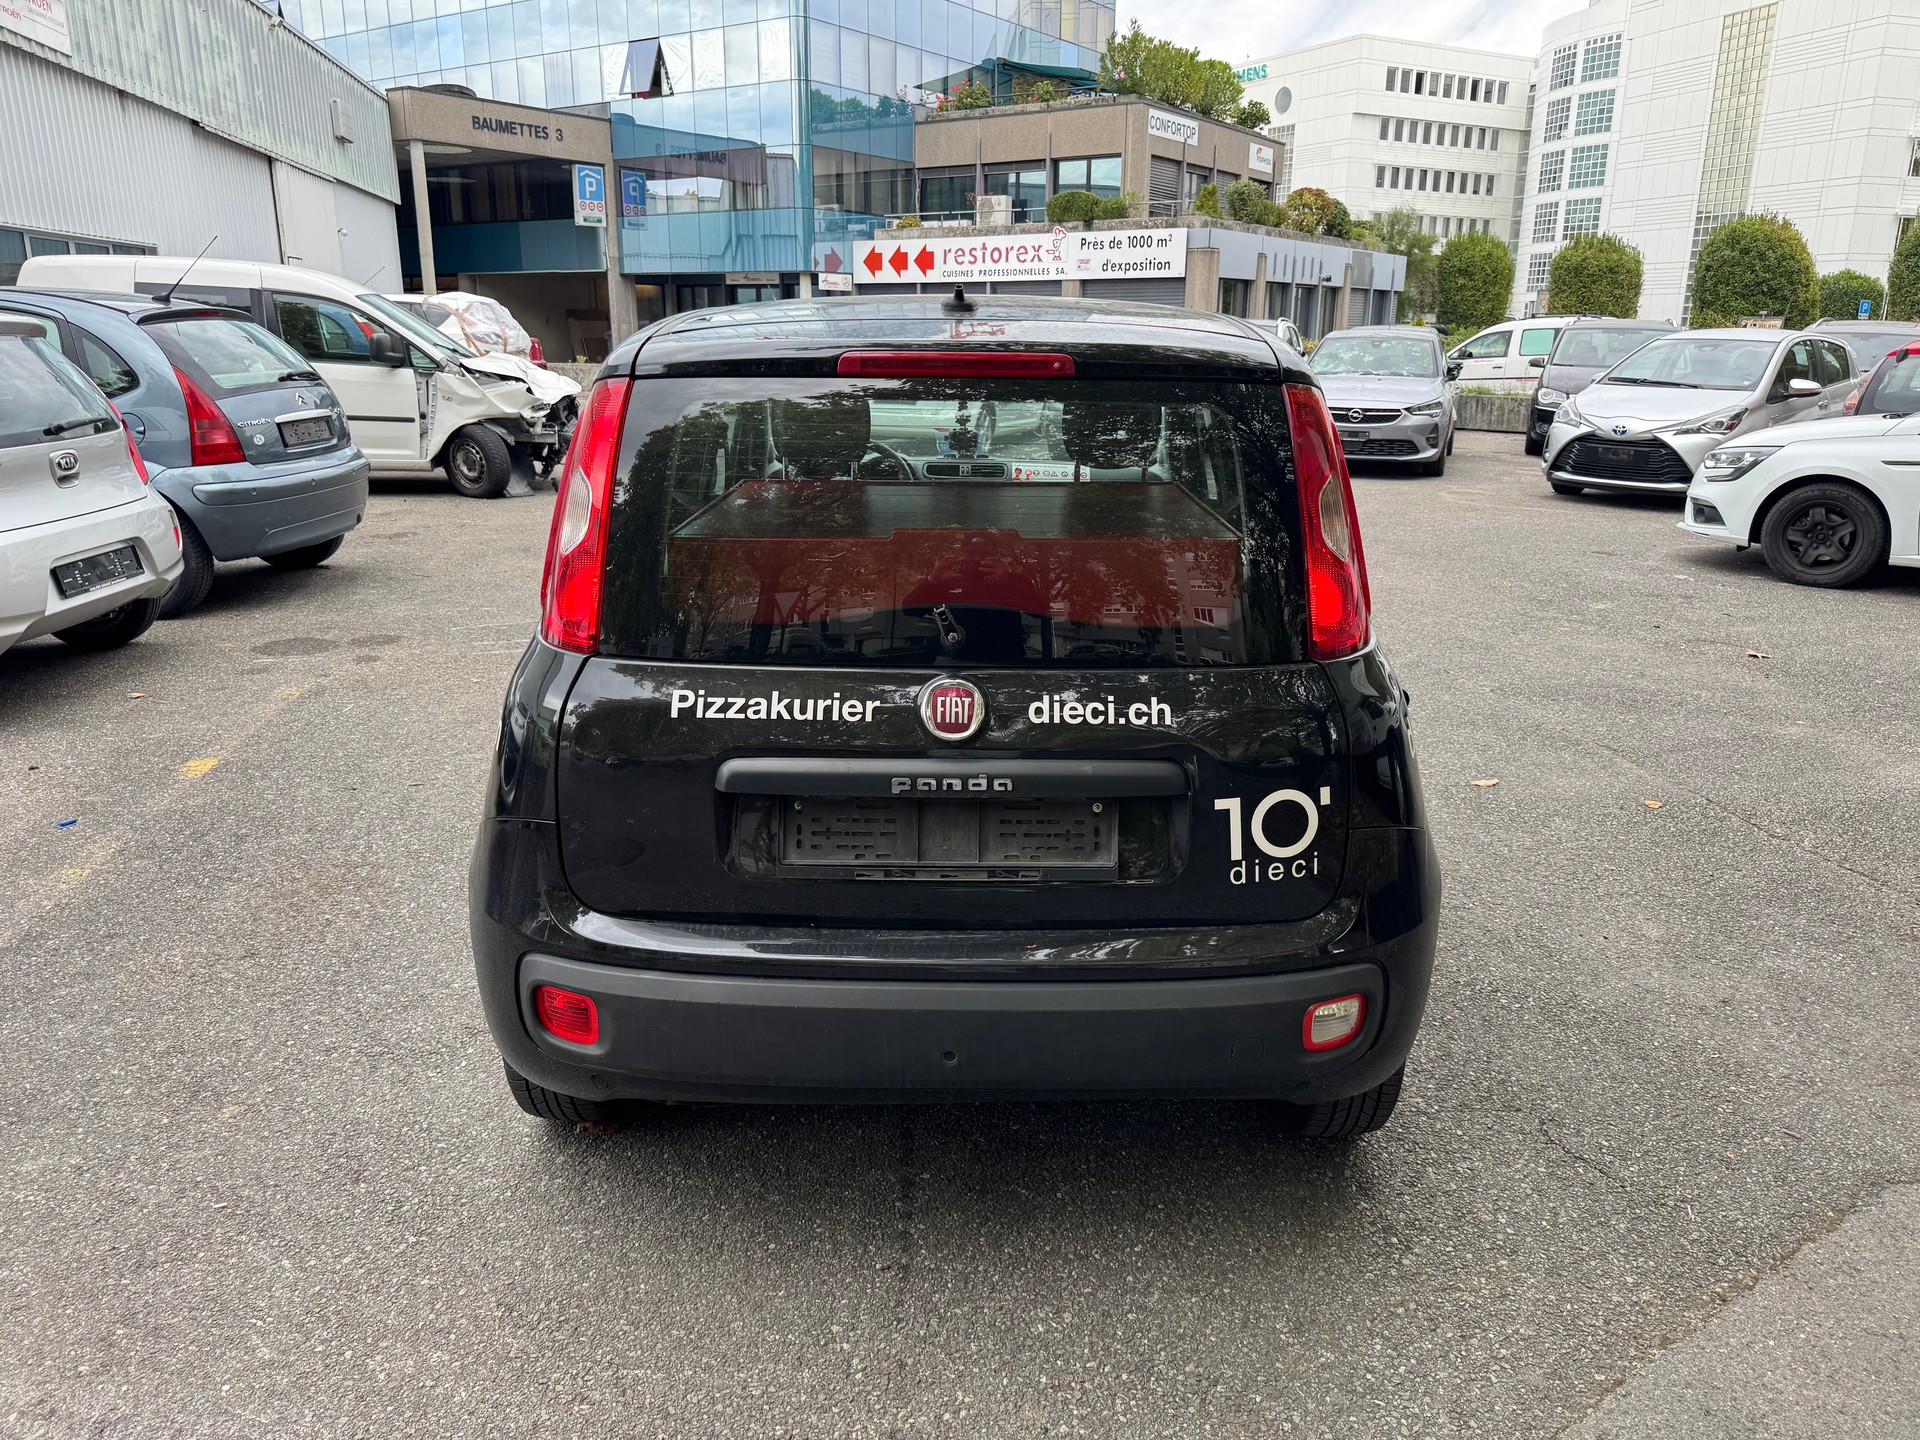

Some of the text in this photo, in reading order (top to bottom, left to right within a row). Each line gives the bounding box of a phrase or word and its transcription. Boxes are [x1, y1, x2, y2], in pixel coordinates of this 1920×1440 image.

[472, 115, 564, 142] BAUMETTES 3
[1149, 115, 1196, 139] CONFORTOP
[585, 177, 596, 199] P
[943, 242, 1044, 265] restorex
[1080, 236, 1104, 250] Près
[1109, 236, 1122, 249] de
[1127, 235, 1153, 248] 1000
[942, 267, 1068, 278] CUISINES PROFESSIONNELLES SA.
[1101, 257, 1171, 275] d'exposition
[60, 457, 77, 470] KIA
[670, 689, 881, 722] Pizzakurier
[937, 696, 972, 724] FIAT
[1028, 694, 1172, 725] dieci.ch
[891, 773, 1013, 794] panda
[1229, 851, 1318, 885] dieci
